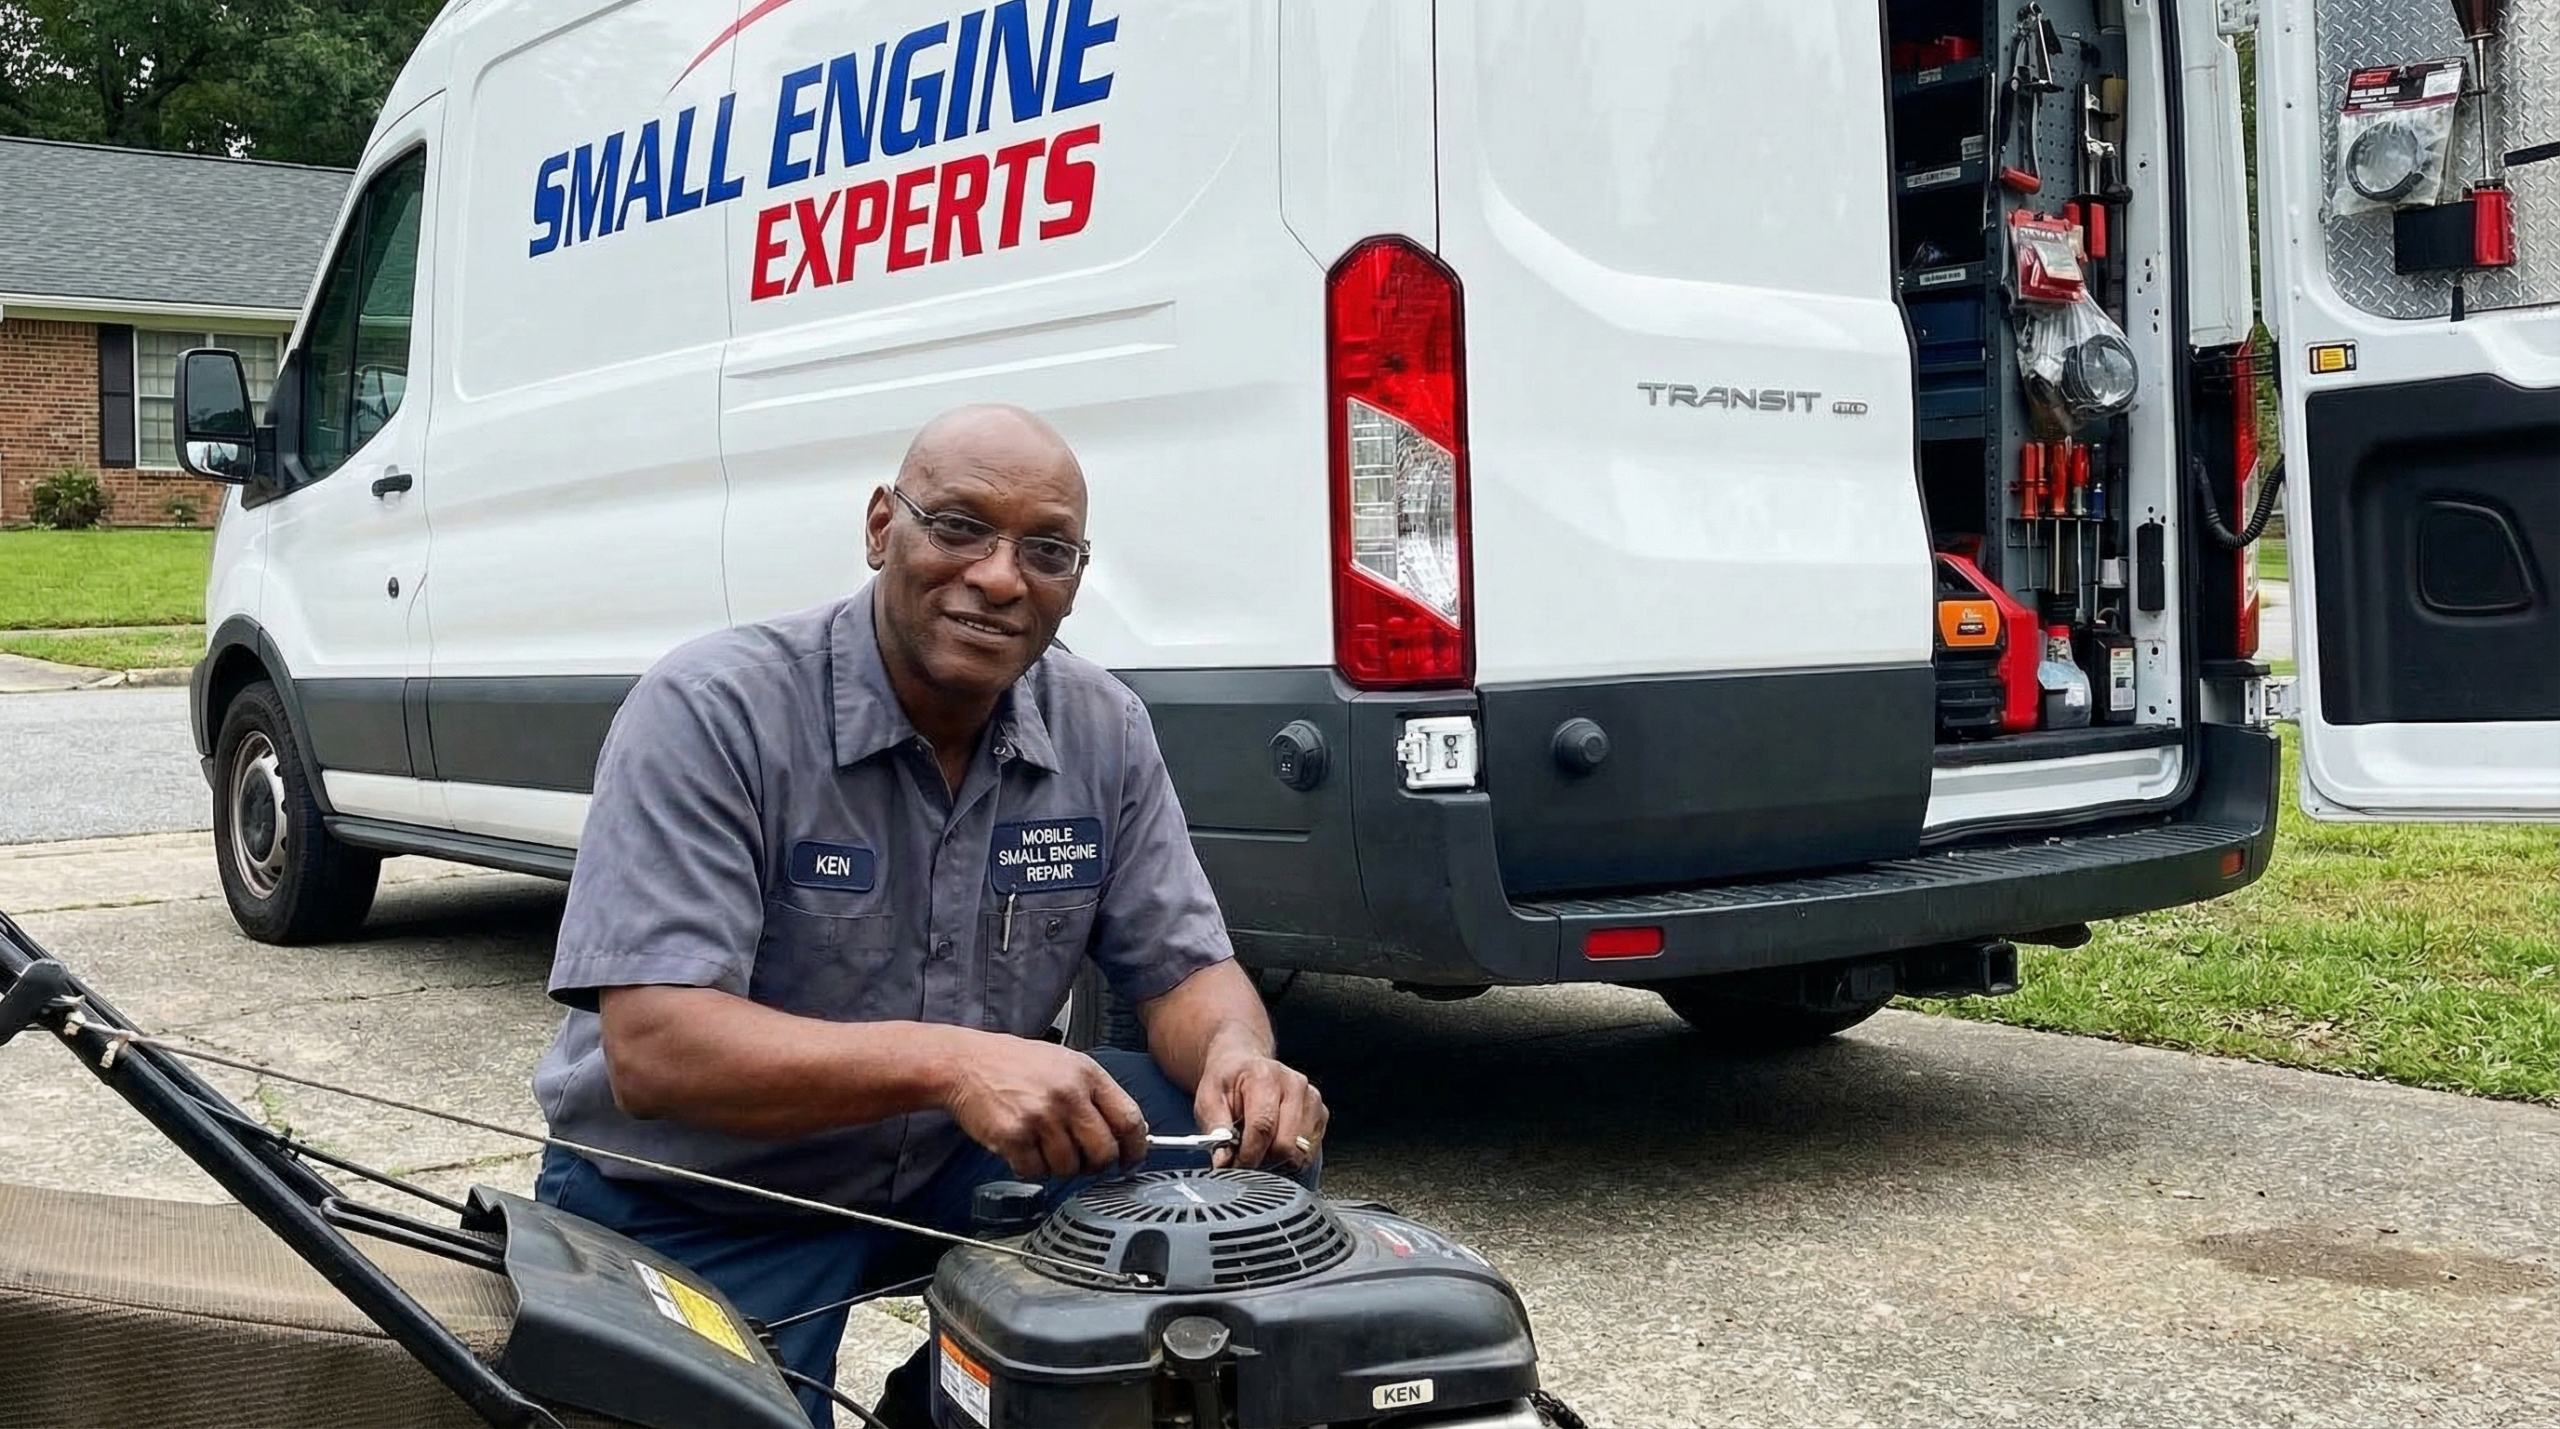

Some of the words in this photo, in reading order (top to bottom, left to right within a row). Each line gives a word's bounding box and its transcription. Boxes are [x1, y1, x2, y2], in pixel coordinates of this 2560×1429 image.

[529, 91, 745, 258] SMALL
[767, 0, 1120, 189] ENGINE
[751, 124, 1100, 301] EXPERTS
[1637, 382, 1822, 413] TRANSIT
[1022, 827, 1073, 846] MOBILE
[815, 855, 851, 877] KEN
[999, 848, 1046, 866] SMALL
[1050, 844, 1097, 861] ENGINE
[1026, 863, 1074, 882] REPAIR
[1384, 1385, 1420, 1405] KEN
